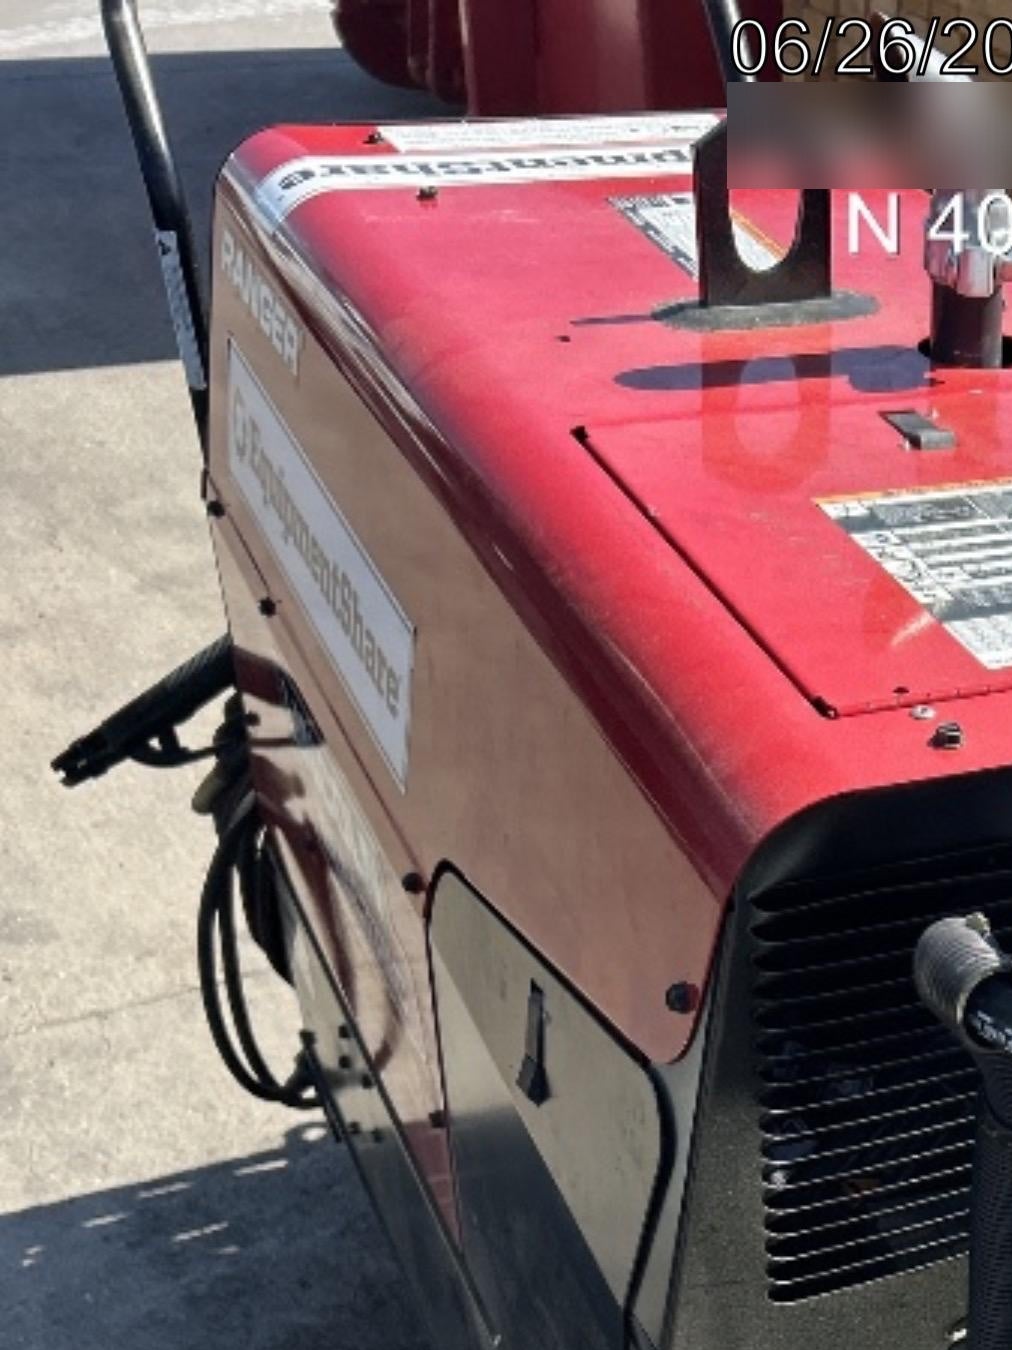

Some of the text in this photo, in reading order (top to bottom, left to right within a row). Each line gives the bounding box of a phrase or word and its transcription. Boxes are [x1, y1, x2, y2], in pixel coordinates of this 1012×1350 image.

[279, 149, 692, 190] pmentShare
[221, 229, 300, 377] RANGER
[250, 418, 402, 722] EquipmentShare
